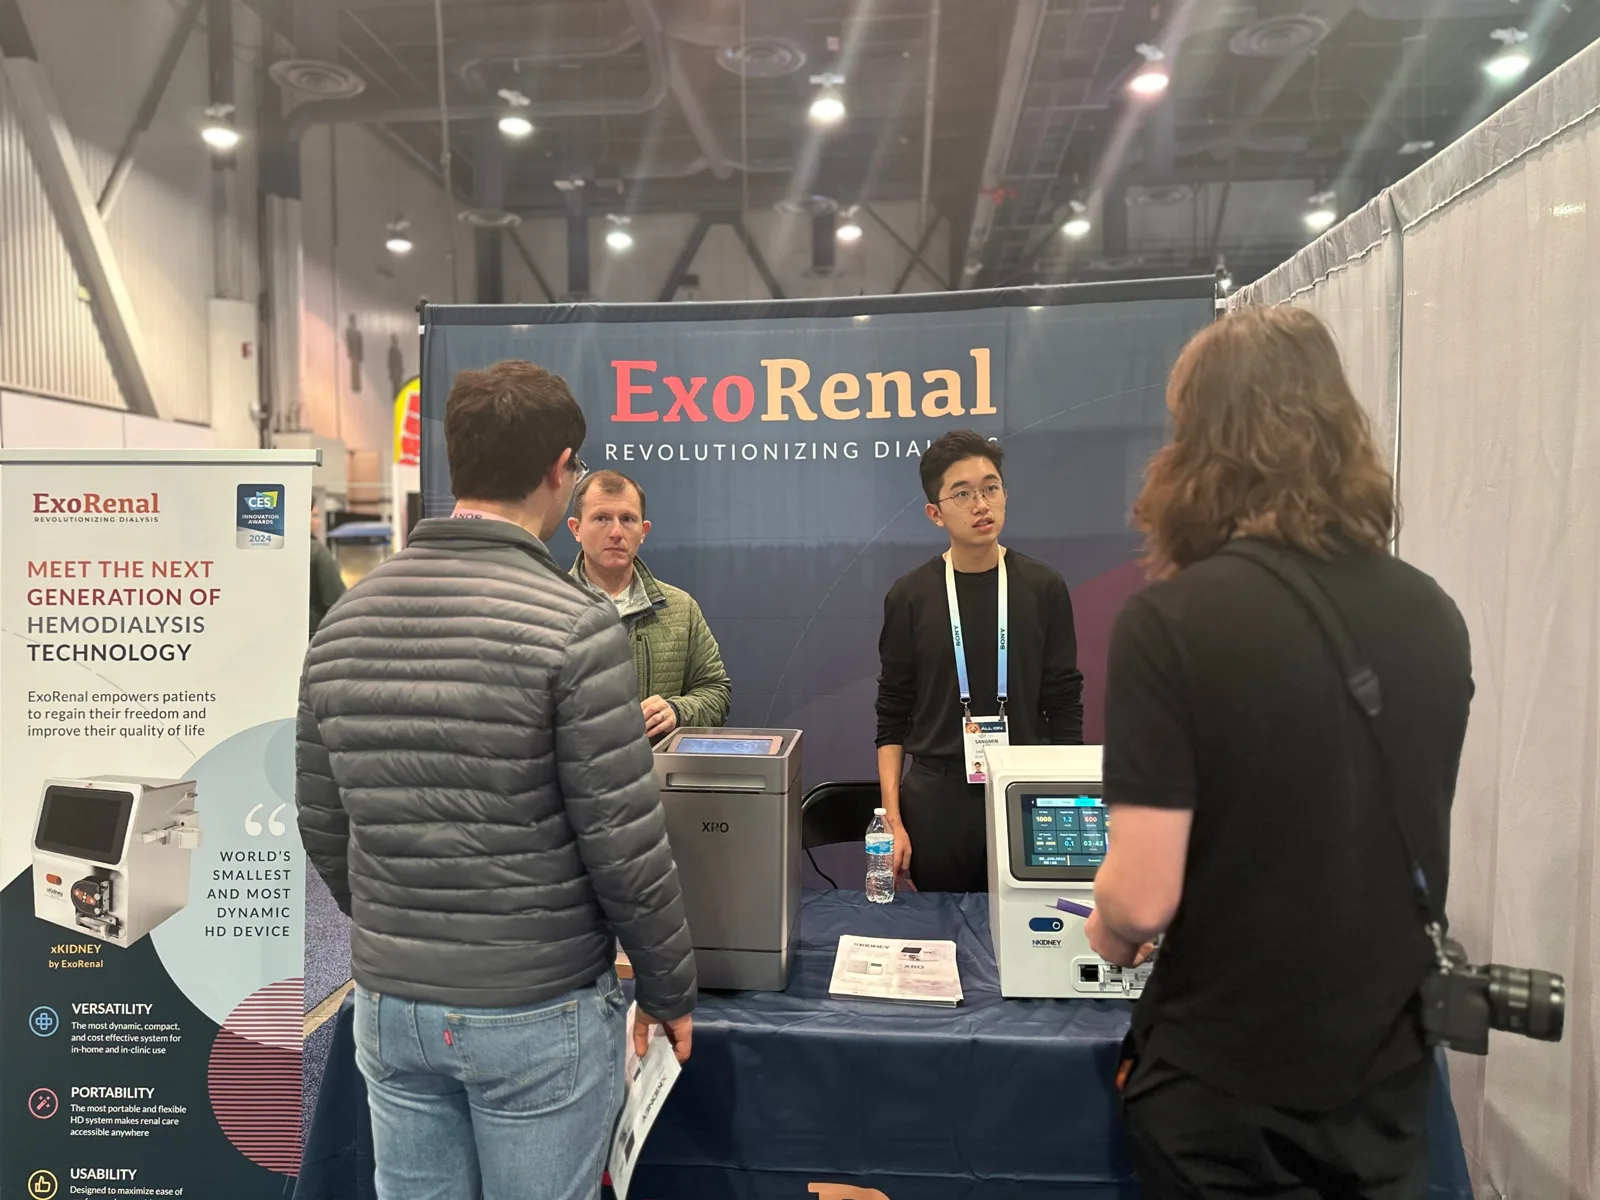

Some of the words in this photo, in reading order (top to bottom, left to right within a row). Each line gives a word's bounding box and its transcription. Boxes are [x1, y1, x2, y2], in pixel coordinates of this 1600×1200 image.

[610, 348, 998, 424] ExoRenal
[605, 439, 859, 462] REVOLUTIONIZING
[33, 492, 160, 514] ExoRenal
[248, 497, 271, 508] CES
[250, 534, 271, 542] 2024
[28, 561, 90, 578] MEET
[98, 561, 144, 578] THE
[152, 561, 214, 578] NEXT
[28, 589, 182, 606] GENERATION
[190, 589, 221, 606] OF
[28, 617, 205, 634] HEMODIALYSIS
[27, 644, 192, 662] TECHNOLOGY
[28, 691, 88, 702] ExoRenal
[92, 693, 159, 705] empowers
[163, 692, 216, 705] patients
[28, 710, 41, 718] to
[45, 709, 86, 722] regain
[90, 708, 121, 718] their
[125, 708, 178, 718] freedom
[182, 708, 206, 718] and
[28, 726, 80, 738] improve
[84, 726, 116, 736] their
[120, 725, 164, 738] quality
[168, 725, 181, 736] of
[184, 725, 205, 736] life
[220, 851, 291, 862] WORLD'S
[213, 870, 291, 880] SMALLEST
[208, 888, 240, 899] AND
[247, 888, 291, 899] MOST
[217, 908, 290, 918] DYNAMIC
[206, 926, 226, 936] HD
[234, 926, 290, 936] DEVICE
[51, 944, 101, 954] xKIDNEY
[49, 960, 59, 968] by
[62, 959, 103, 968] ExoRenal
[72, 1004, 152, 1014] VERSATILITY
[72, 1022, 86, 1030] The
[88, 1022, 108, 1030] most
[109, 1022, 143, 1032] dynamic,
[105, 1034, 138, 1042] effective
[140, 1035, 168, 1044] system
[170, 1034, 181, 1042] for
[72, 1046, 103, 1054] in-home
[105, 1046, 119, 1054] and
[121, 1046, 150, 1054] in-clinic
[72, 1088, 154, 1098] PORTABILITY
[71, 1104, 85, 1112] The
[108, 1105, 140, 1115] portable
[142, 1105, 156, 1113] and
[158, 1105, 186, 1114] flexible
[70, 1116, 84, 1124] HD
[86, 1118, 113, 1126] system
[114, 1116, 138, 1125] makes
[140, 1116, 160, 1125] renal
[70, 1128, 110, 1136] accessible
[111, 1129, 149, 1138] anywhere
[71, 1168, 137, 1180] USABILITY
[70, 1186, 106, 1197] Designed
[118, 1186, 154, 1195] maximize
[174, 1187, 184, 1195] of
